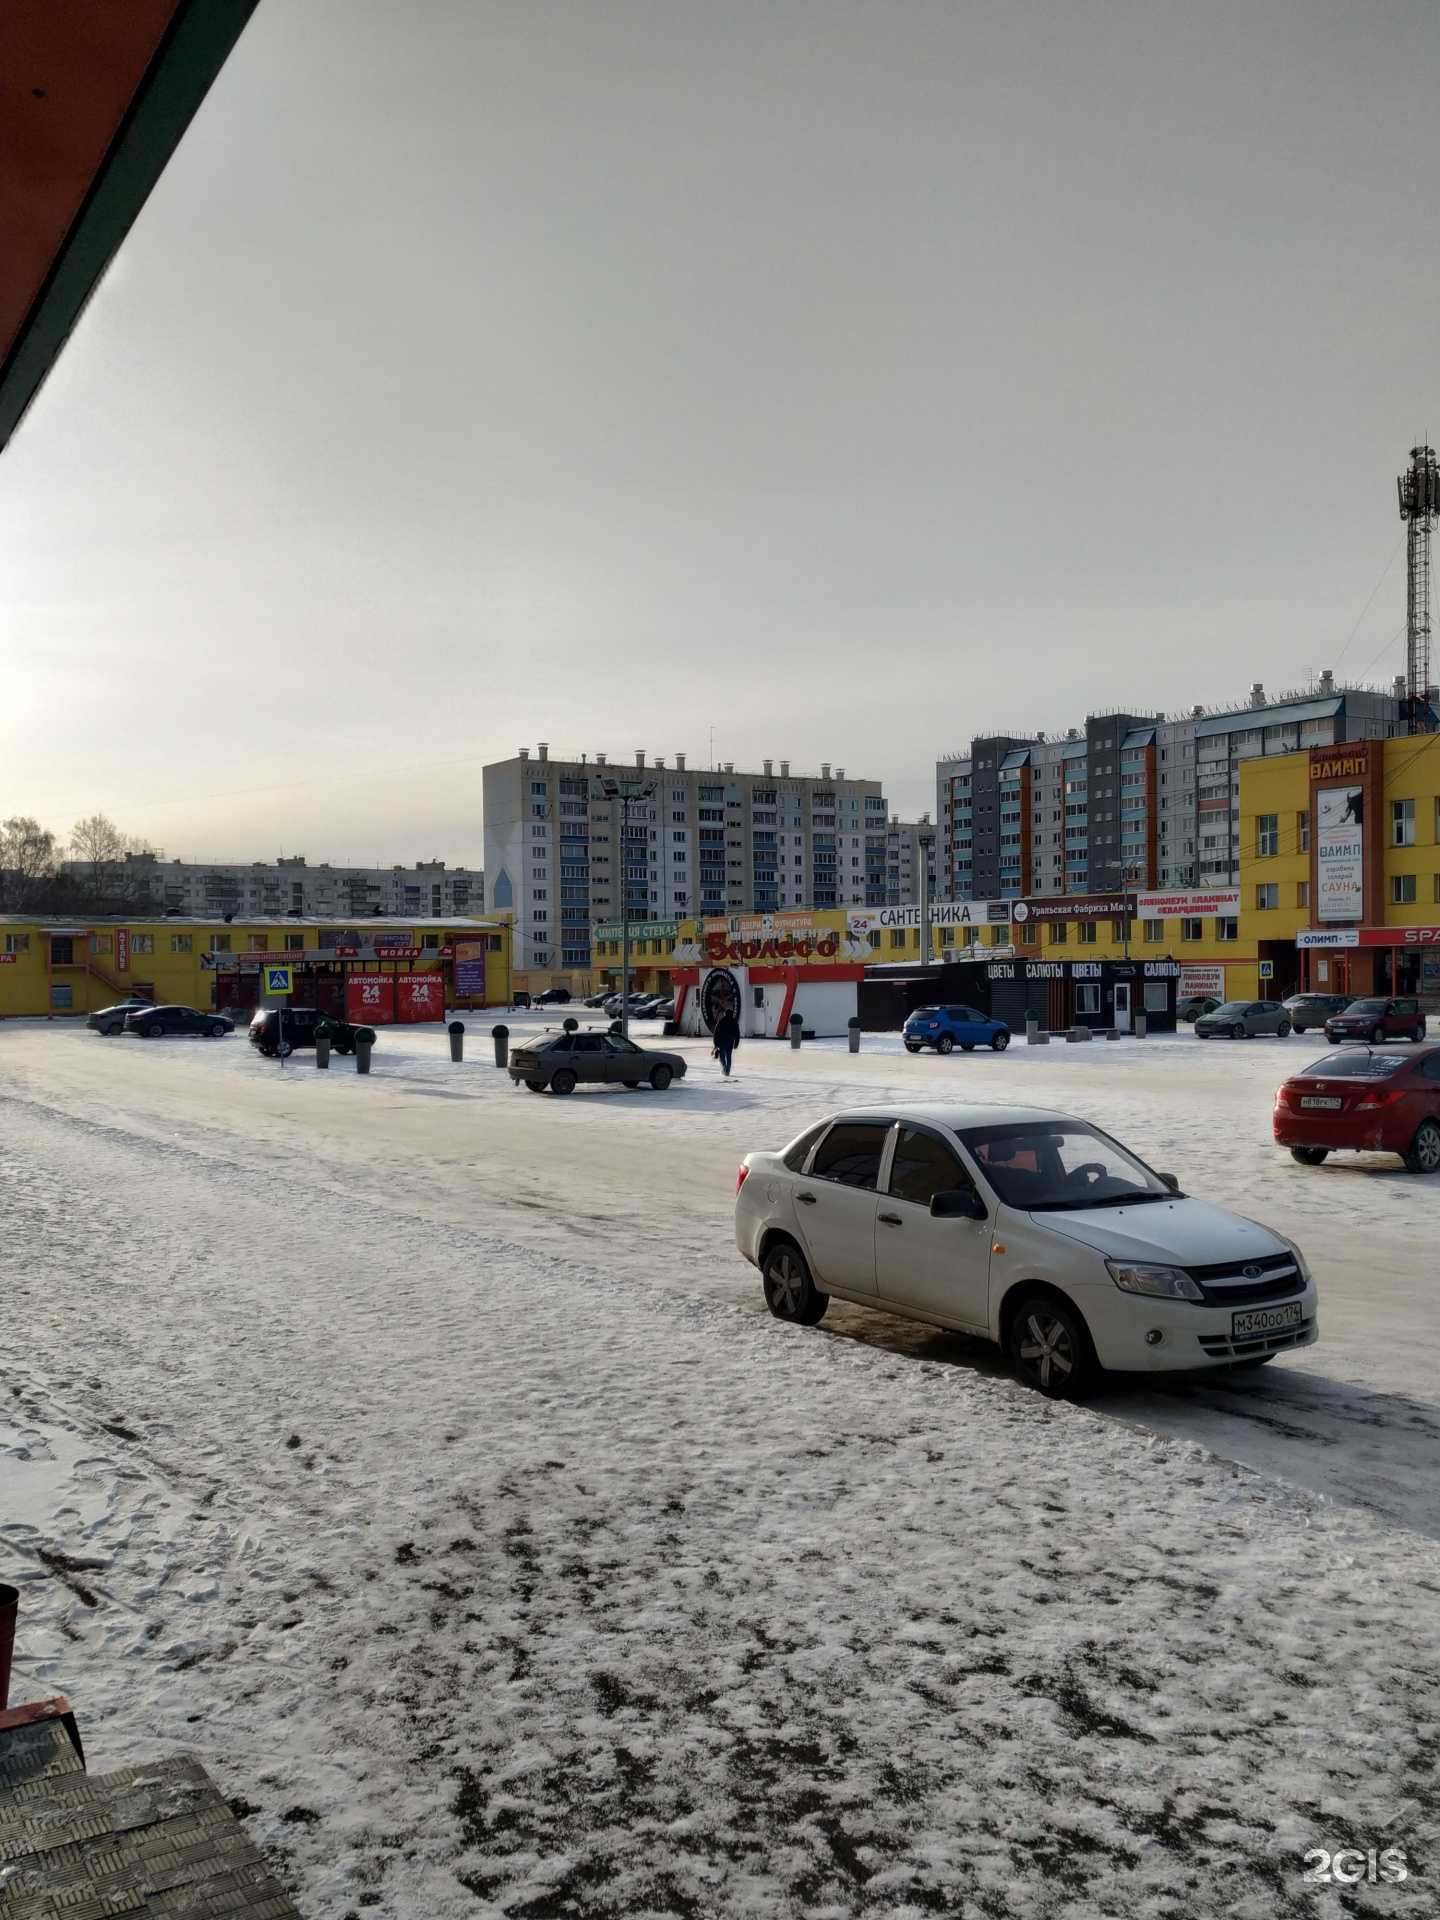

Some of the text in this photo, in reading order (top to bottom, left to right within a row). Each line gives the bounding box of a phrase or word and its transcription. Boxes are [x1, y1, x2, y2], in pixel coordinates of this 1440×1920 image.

[880, 906, 971, 926] САНТЕНИКА
[1031, 906, 1072, 916] Уральская
[1073, 904, 1109, 915] Фабрика
[853, 919, 868, 929] 24
[1303, 935, 1339, 944] ОЛИМП
[380, 949, 419, 957] МОЙКА
[987, 964, 1015, 979] ЦВЕТЫ
[1025, 963, 1064, 979] САЛЮТЫ
[1071, 963, 1102, 979] ЦВЕТЫ
[1143, 962, 1180, 977] САЛЮТЫ
[348, 976, 393, 985] АВТОМОЙКА
[398, 975, 442, 984] АВТОМОЙКА
[362, 985, 380, 998] 24
[411, 984, 430, 997] 24
